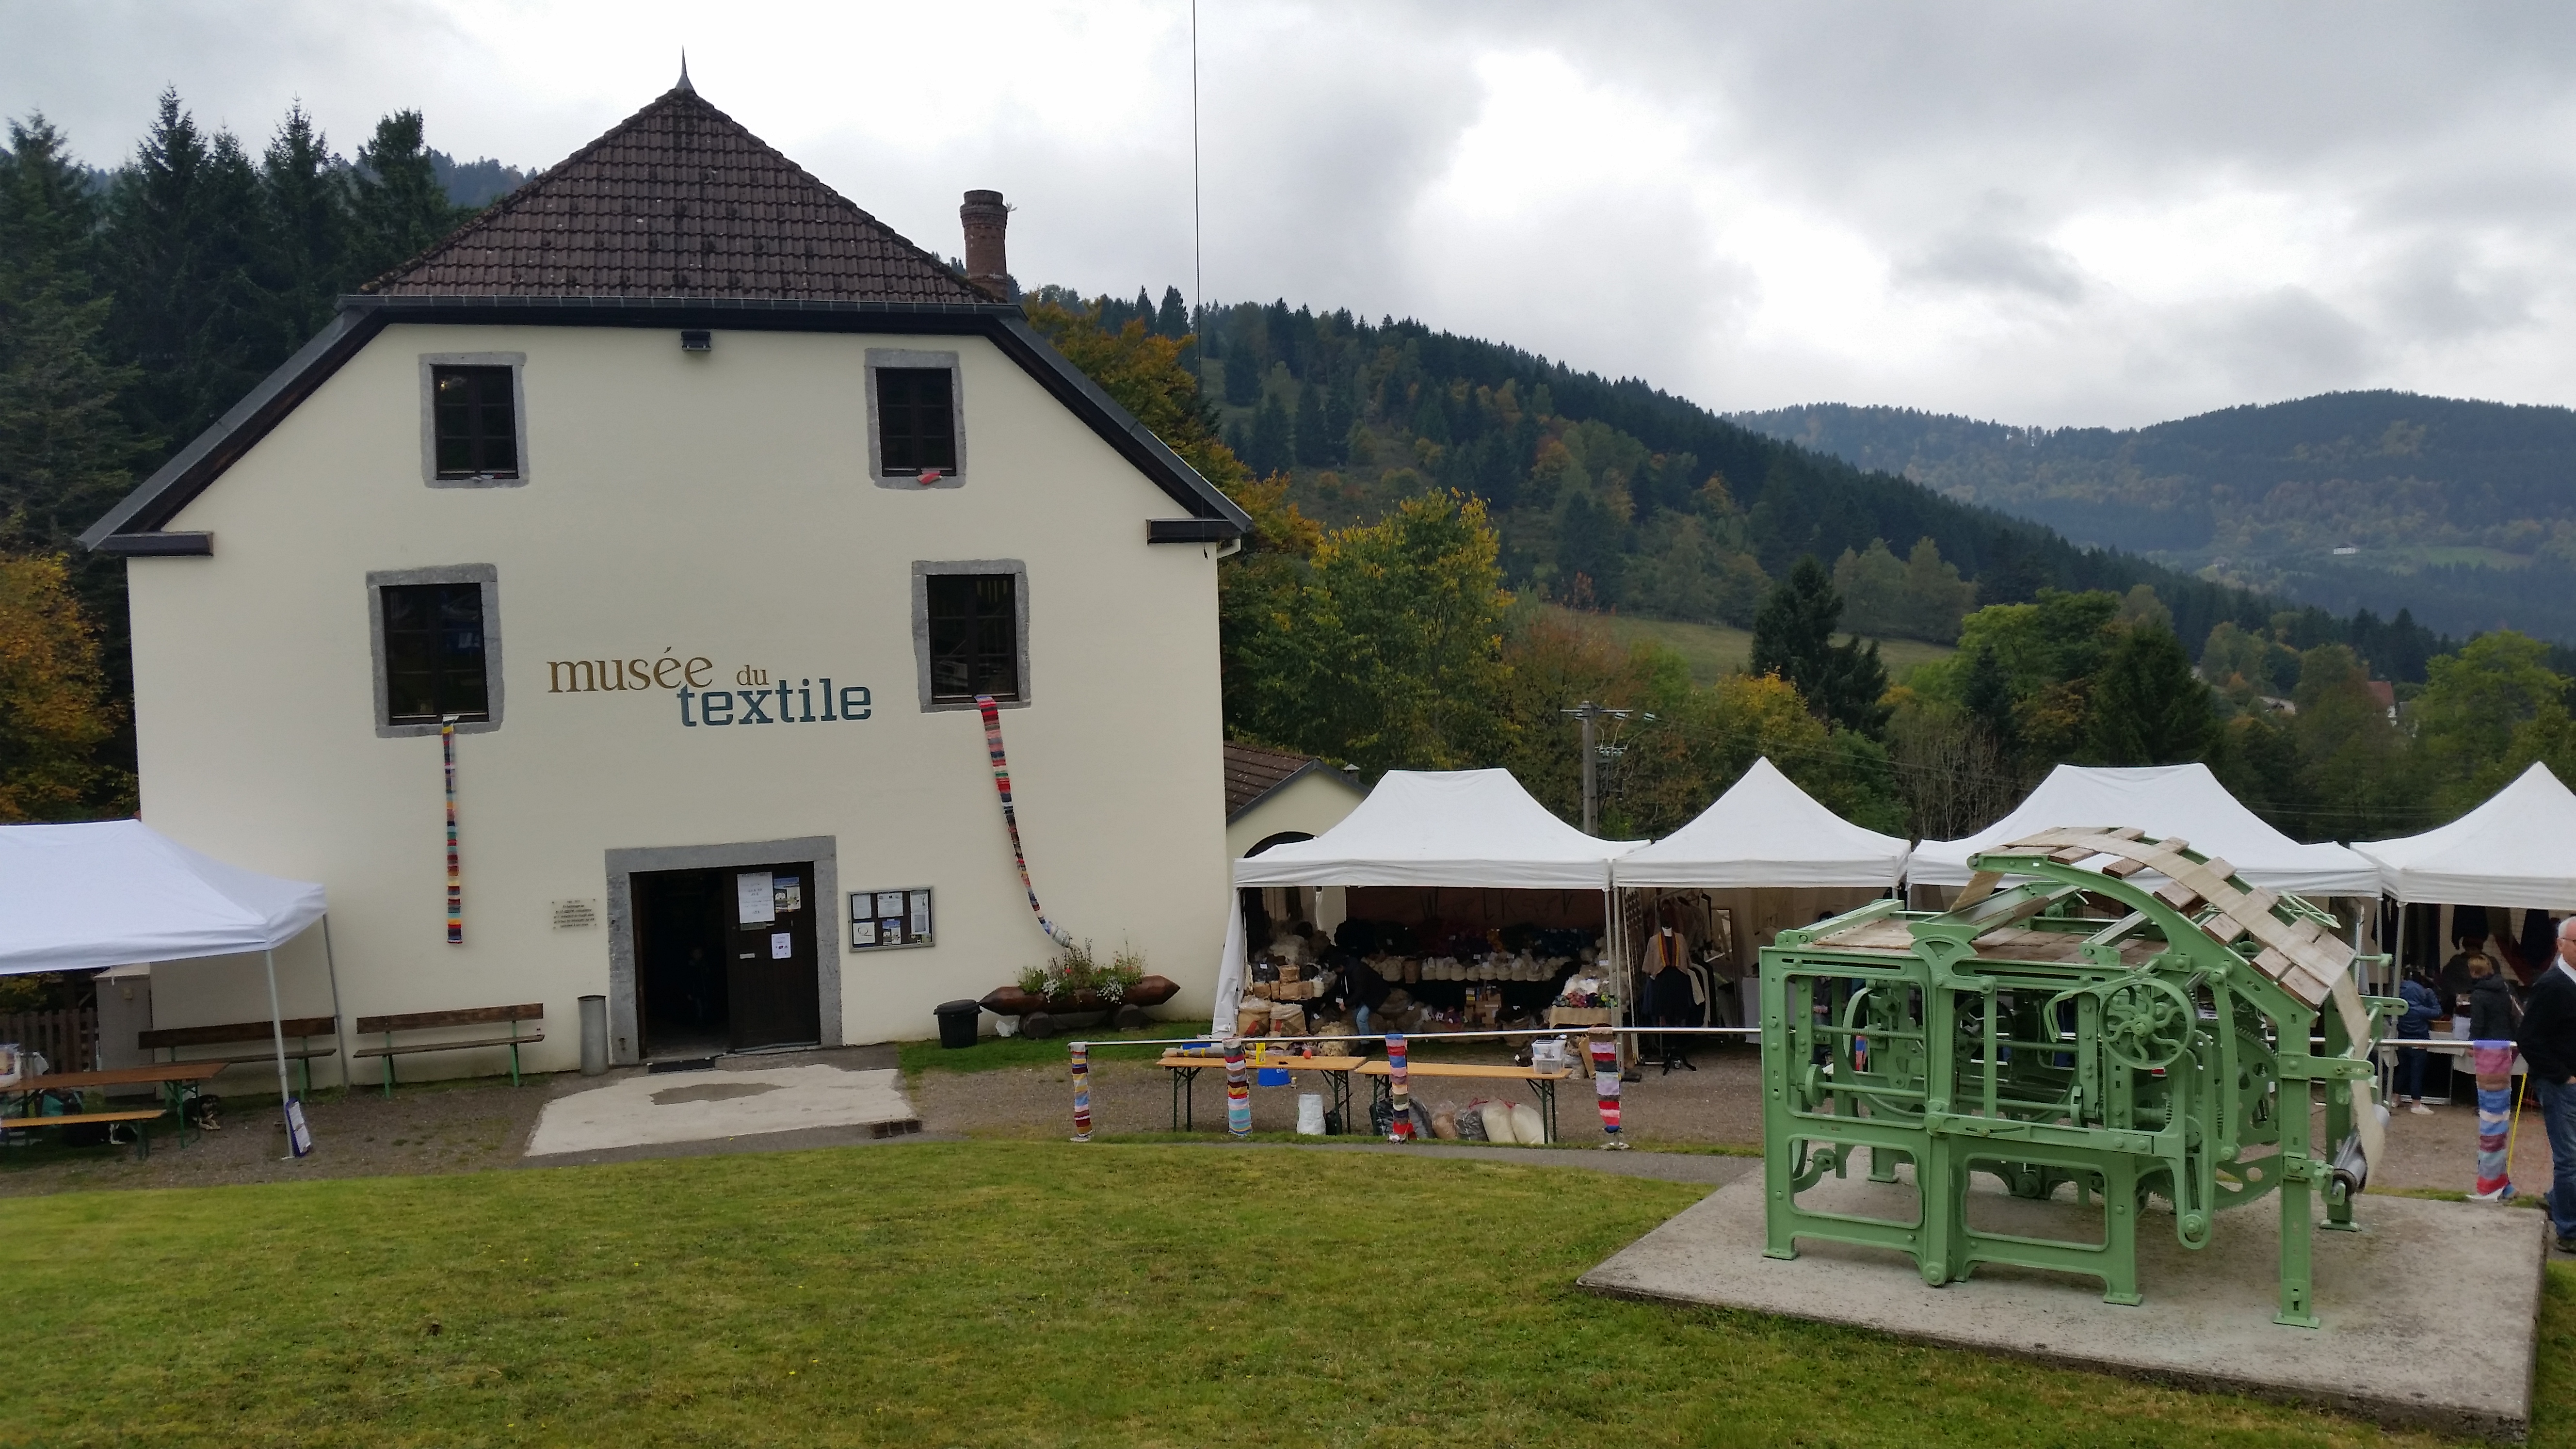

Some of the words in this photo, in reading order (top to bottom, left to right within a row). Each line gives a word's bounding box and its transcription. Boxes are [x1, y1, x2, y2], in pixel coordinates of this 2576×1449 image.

[547, 646, 713, 693] musée
[736, 664, 770, 686] du
[676, 678, 872, 727] textile
